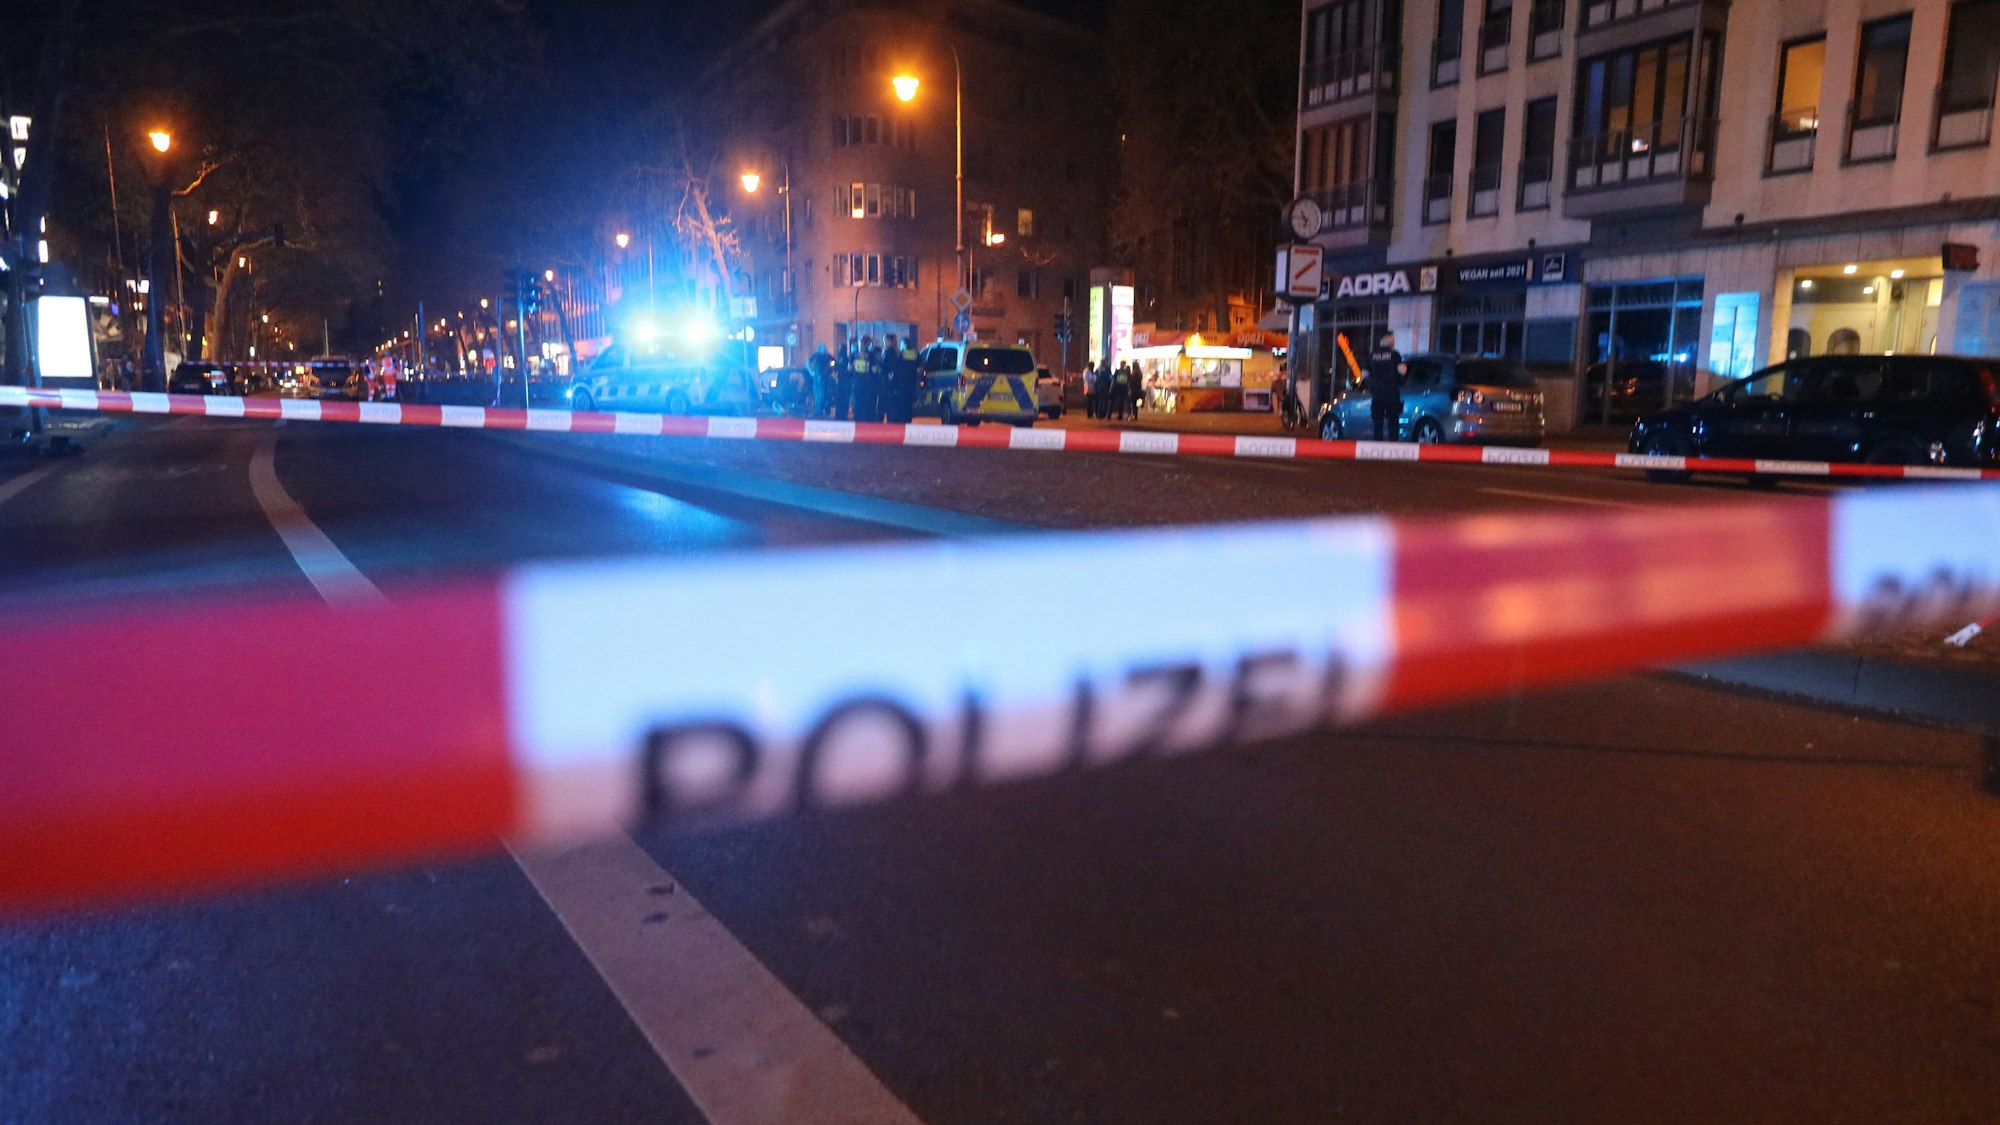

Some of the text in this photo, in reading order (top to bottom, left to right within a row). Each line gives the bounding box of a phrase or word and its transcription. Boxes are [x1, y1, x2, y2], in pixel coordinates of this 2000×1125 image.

[1459, 265, 1525, 281] VEGAN seit 2021
[1337, 270, 1411, 298] AORA
[1372, 352, 1392, 361] POLIZEI
